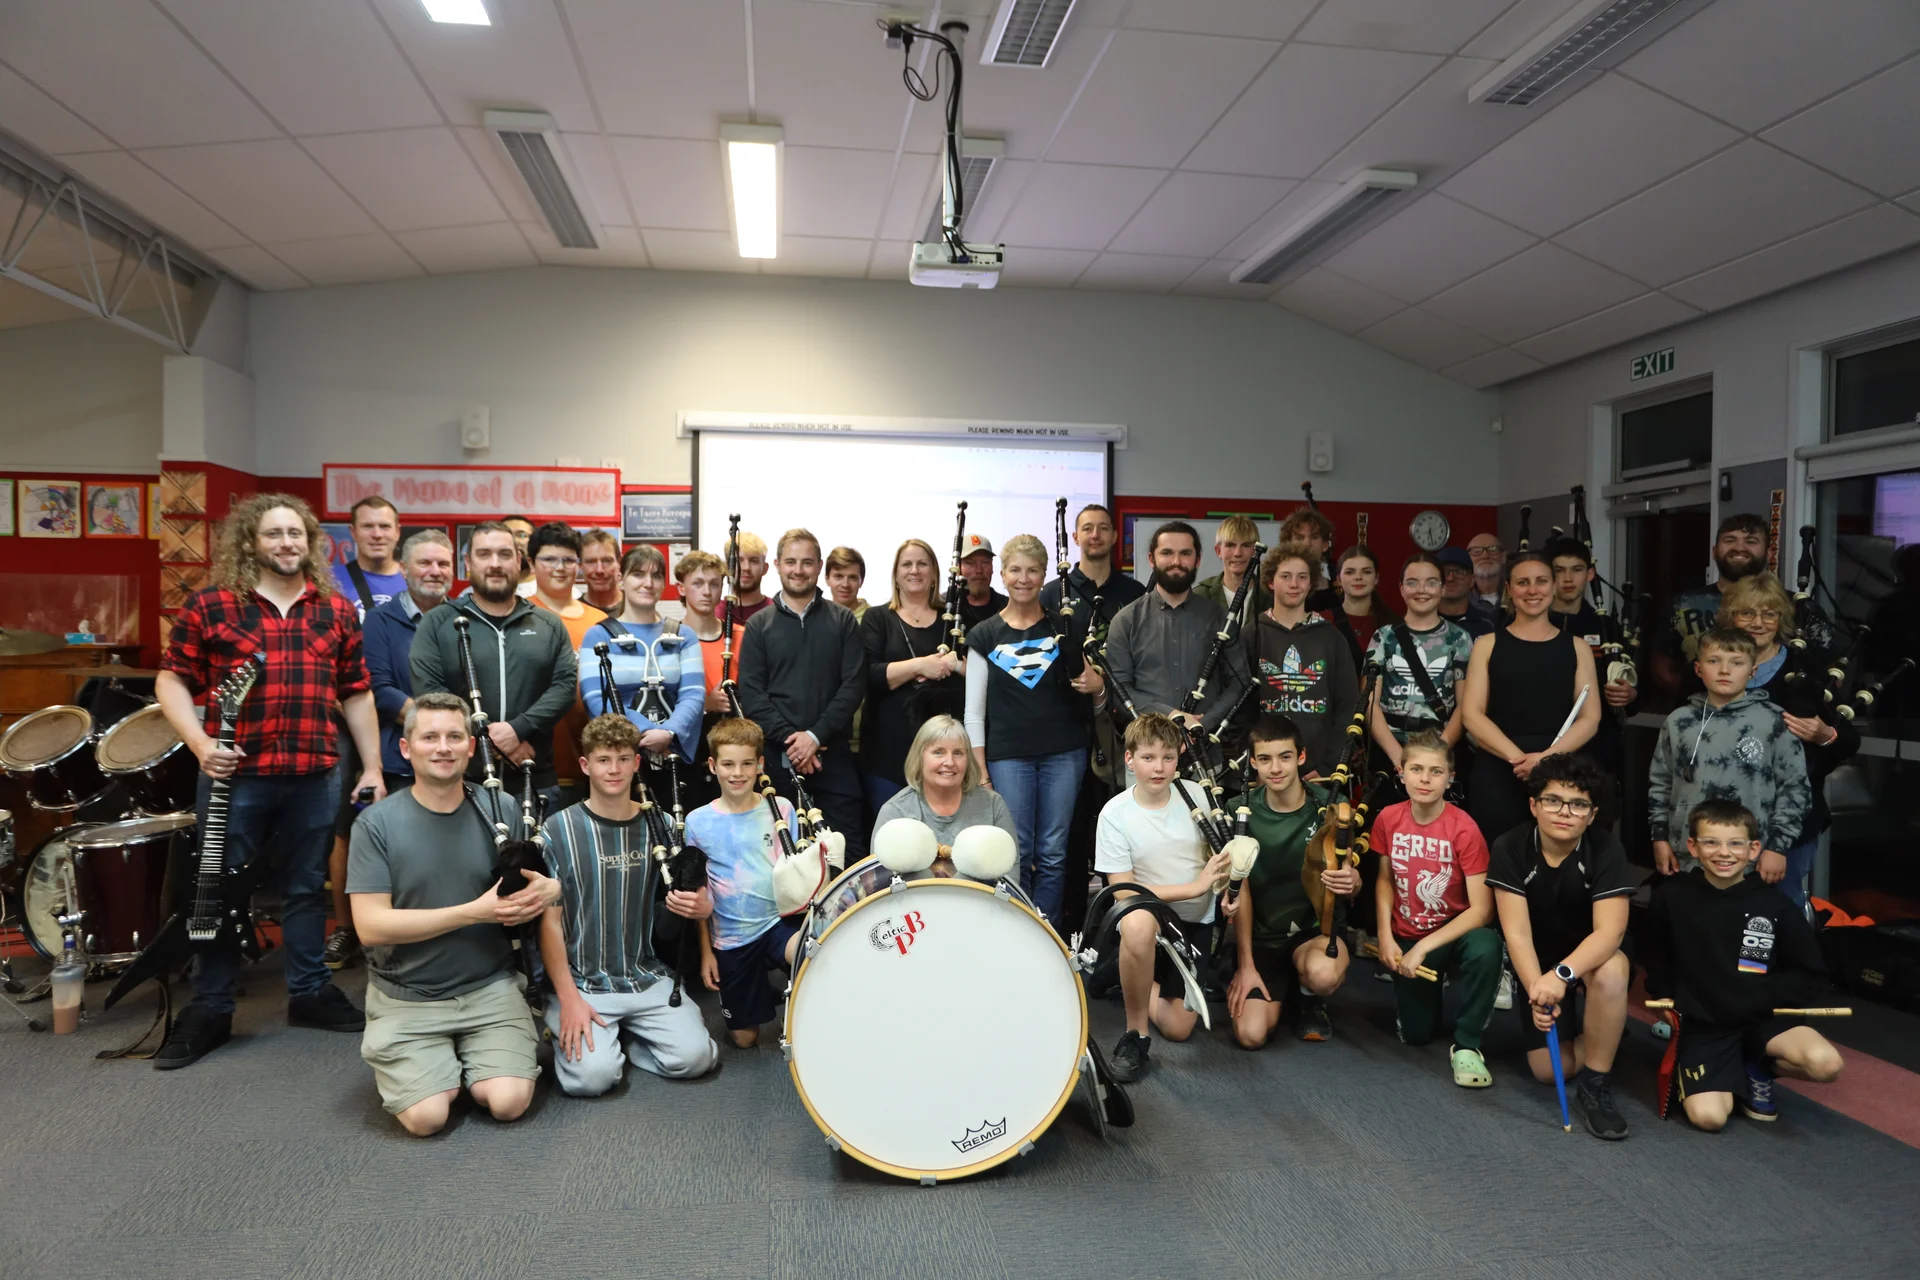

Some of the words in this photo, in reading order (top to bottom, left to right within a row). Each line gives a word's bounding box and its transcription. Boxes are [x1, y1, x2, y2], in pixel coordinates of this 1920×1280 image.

[1631, 348, 1674, 380] EXIT
[991, 427, 1015, 435] REWIND
[1391, 682, 1443, 698] adids
[1260, 693, 1327, 713] adidas
[1410, 834, 1453, 862] RED
[599, 852, 629, 865] Supply
[1742, 935, 1774, 949] 03
[962, 1127, 1002, 1150] REMO
